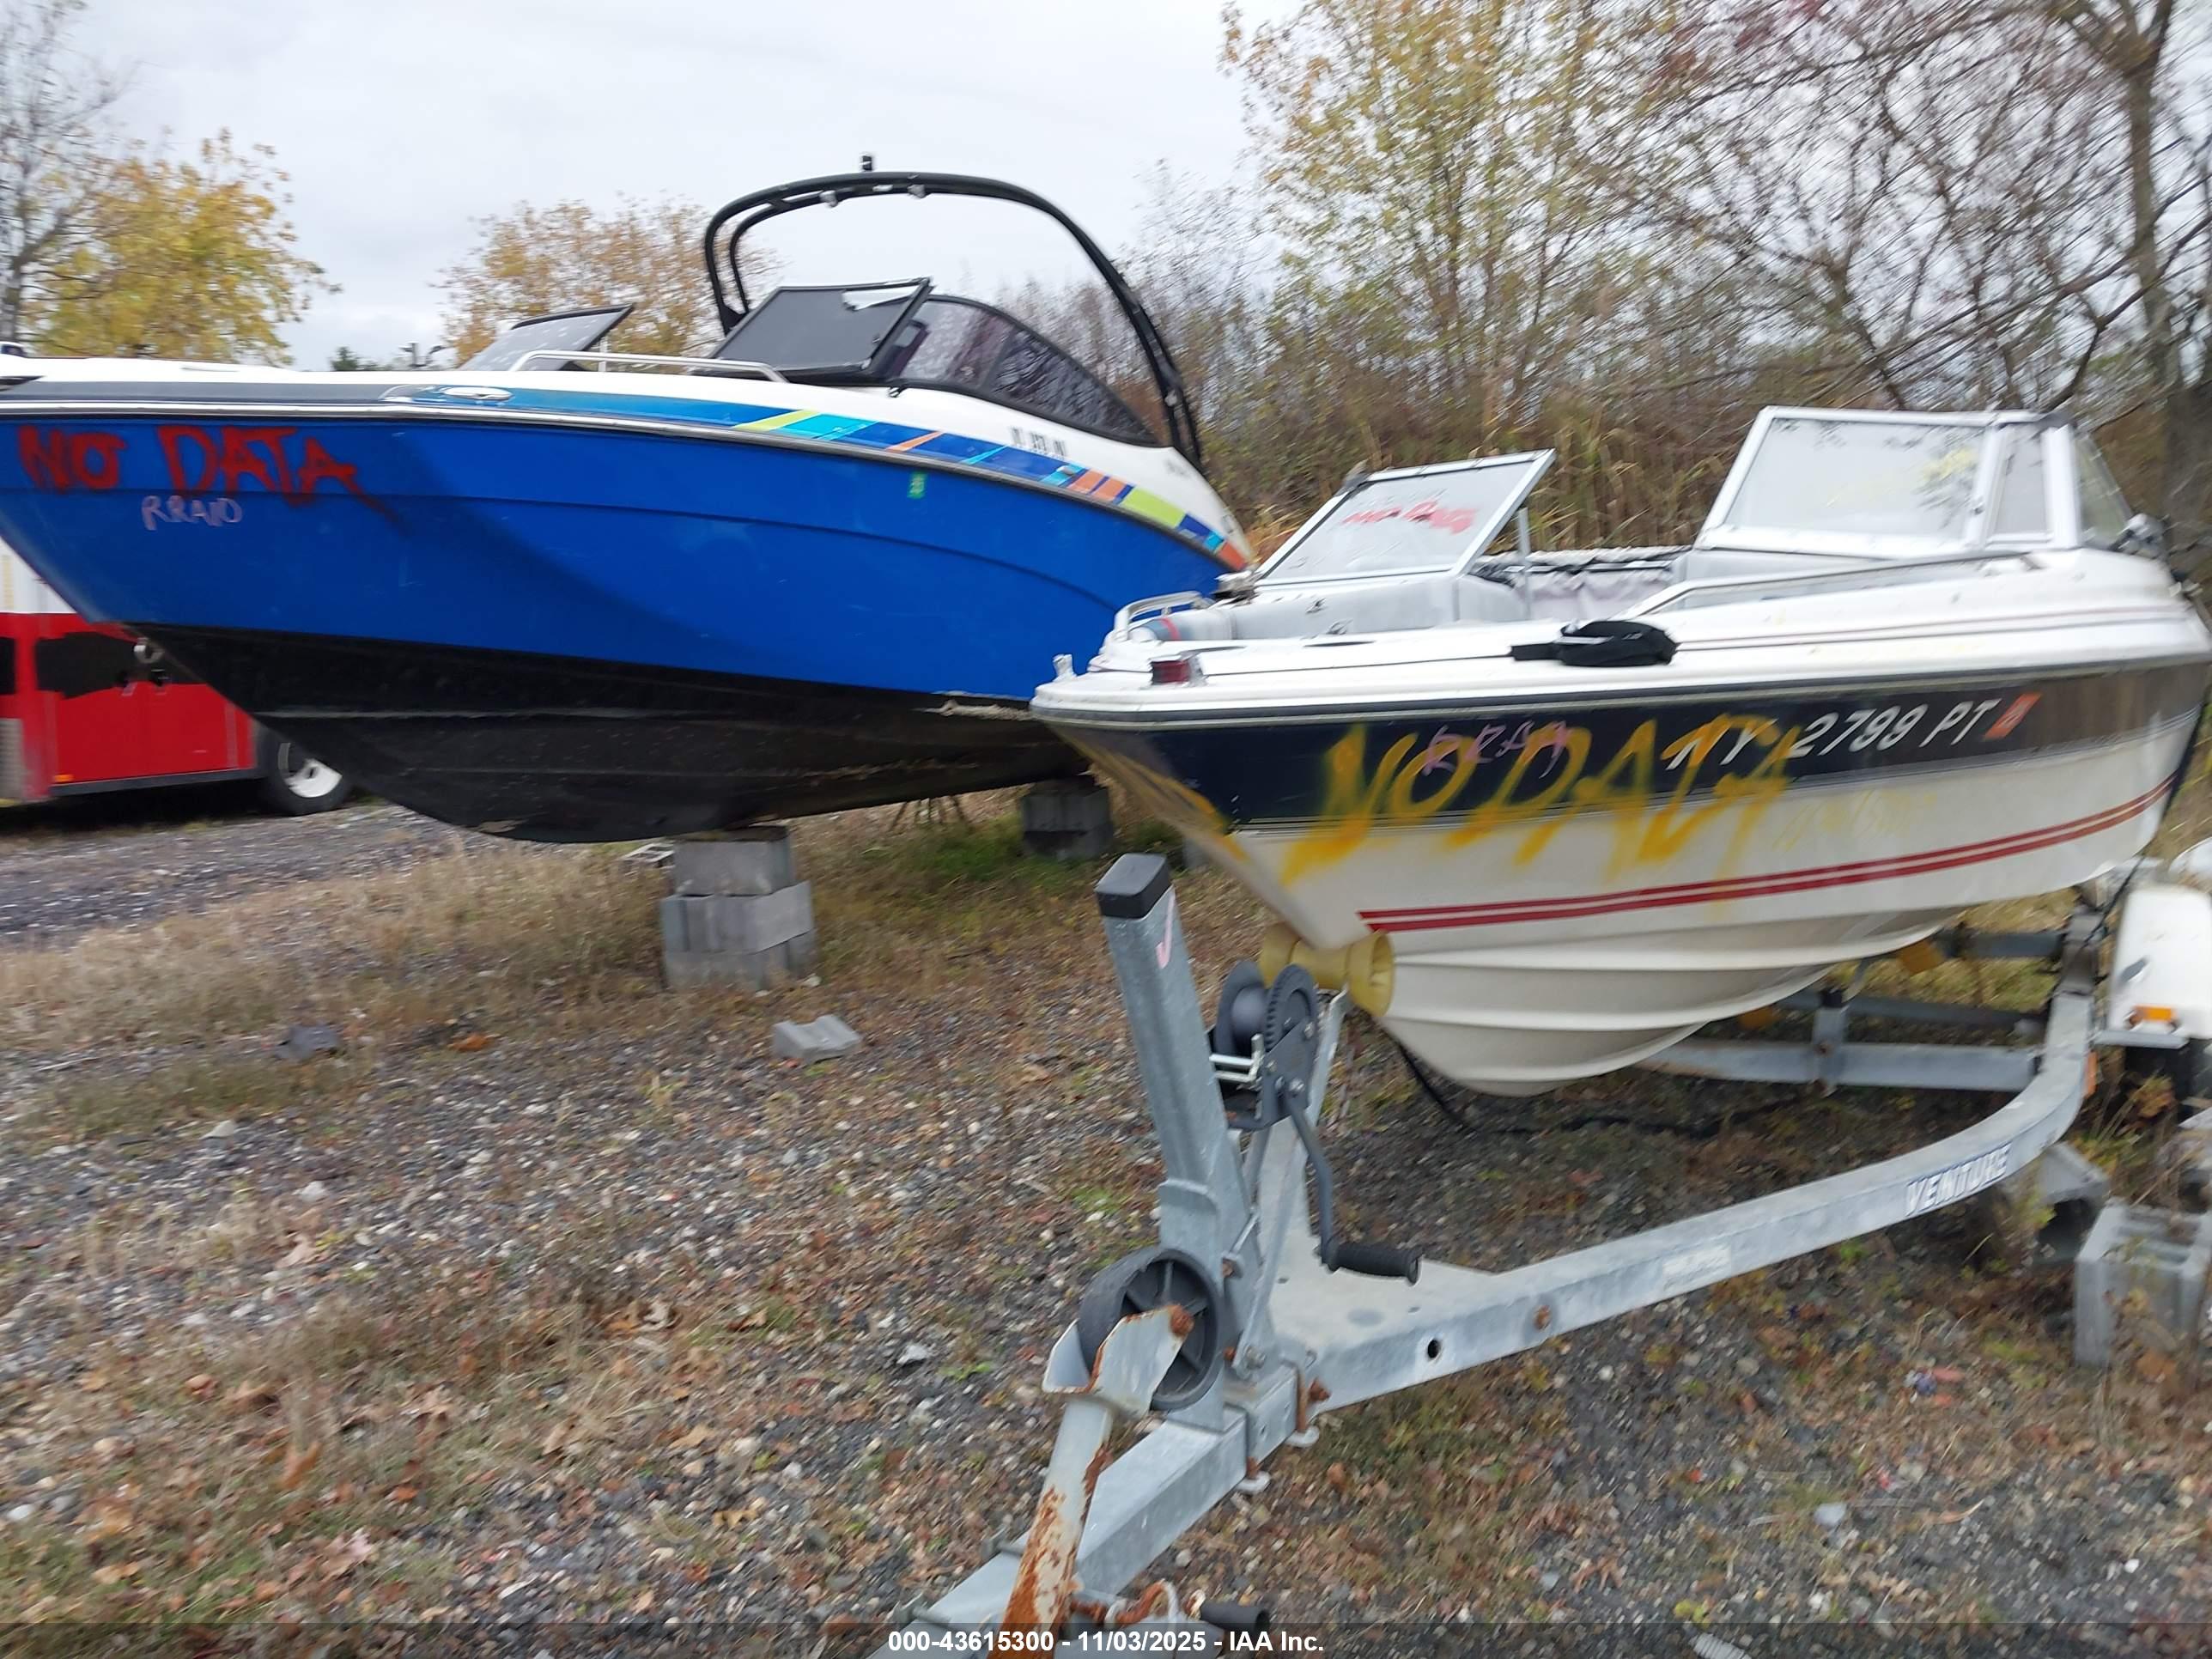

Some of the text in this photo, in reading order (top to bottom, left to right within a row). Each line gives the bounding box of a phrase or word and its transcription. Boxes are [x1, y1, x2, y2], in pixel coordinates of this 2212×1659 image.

[18, 425, 405, 522] NO DATA
[1786, 703, 1929, 759] 2799
[1918, 697, 2002, 747] PT
[1279, 713, 1803, 923] NO DATA
